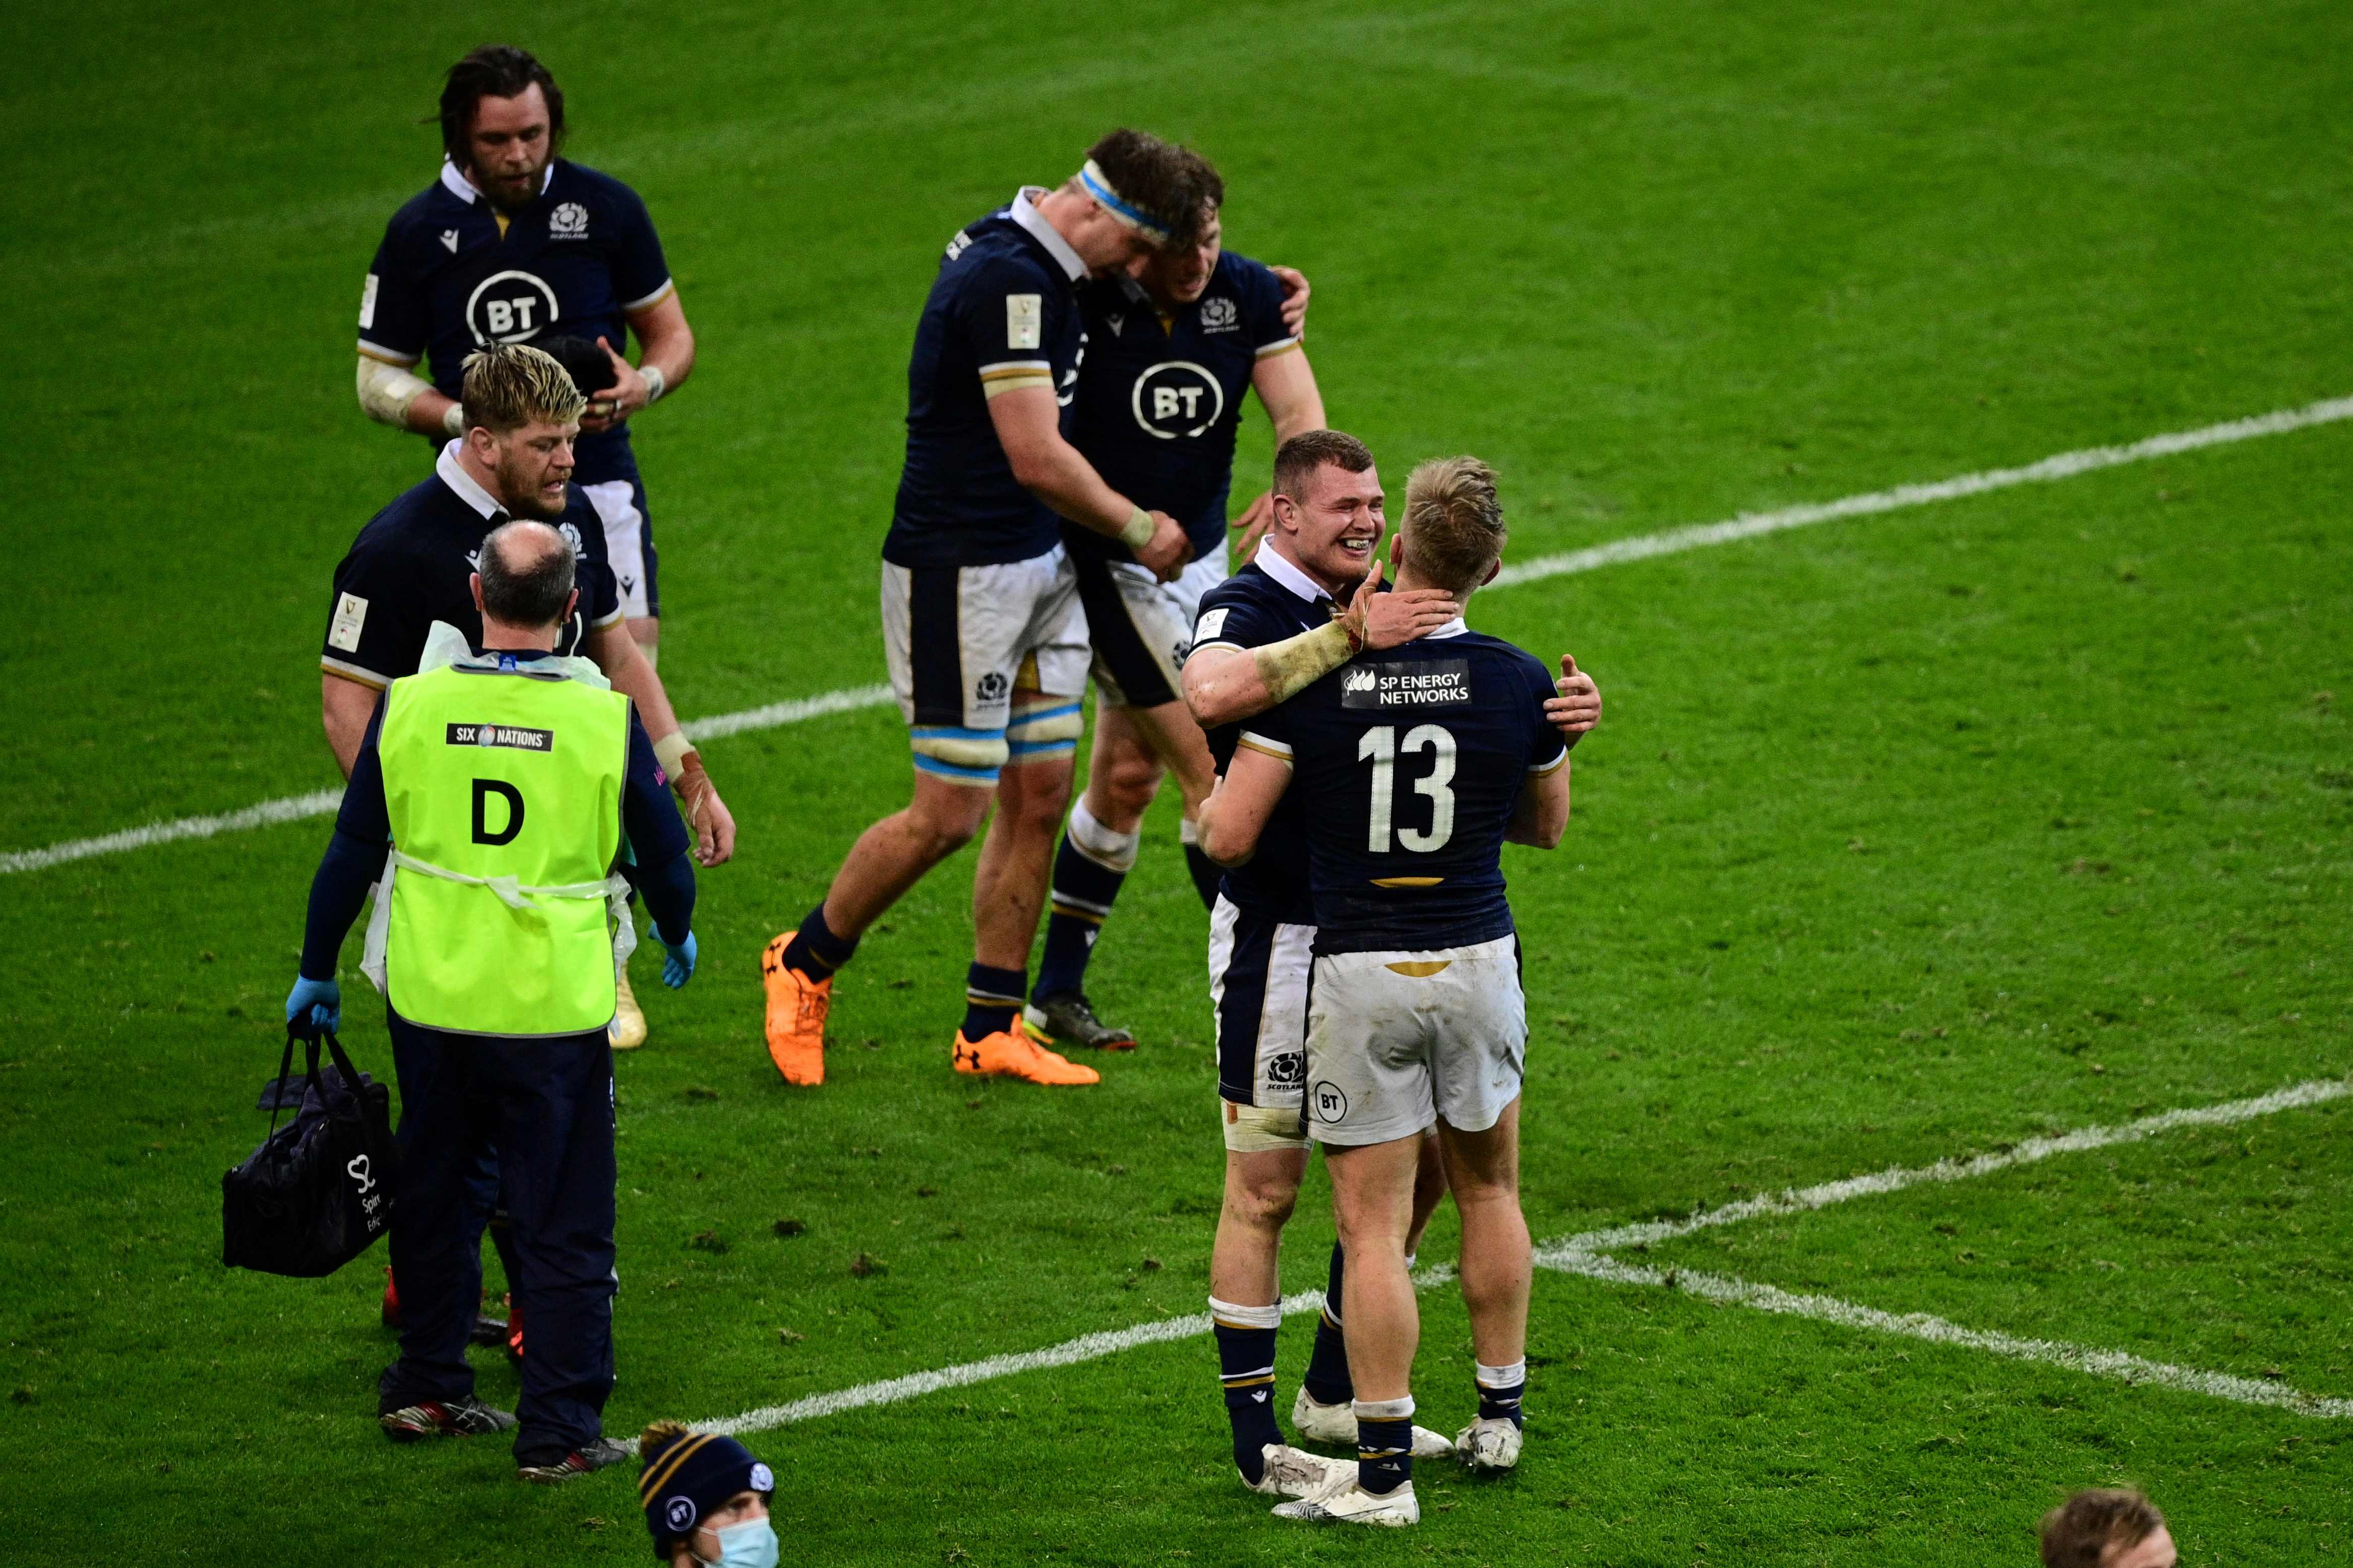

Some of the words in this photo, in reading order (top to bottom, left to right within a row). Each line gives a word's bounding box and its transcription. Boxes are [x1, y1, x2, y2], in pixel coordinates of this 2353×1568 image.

[487, 296, 536, 334] BT
[1154, 386, 1203, 419] BT
[1379, 676, 1398, 689] SP
[1401, 673, 1461, 688] ENERGY
[1380, 687, 1469, 705] NETWORKS
[456, 727, 475, 741] SIX
[497, 729, 543, 747] NATIONS
[1358, 724, 1457, 853] 13
[472, 779, 525, 846] D
[1321, 1093, 1338, 1110] BT
[362, 1193, 381, 1215] Spire
[671, 1504, 687, 1522] BT
